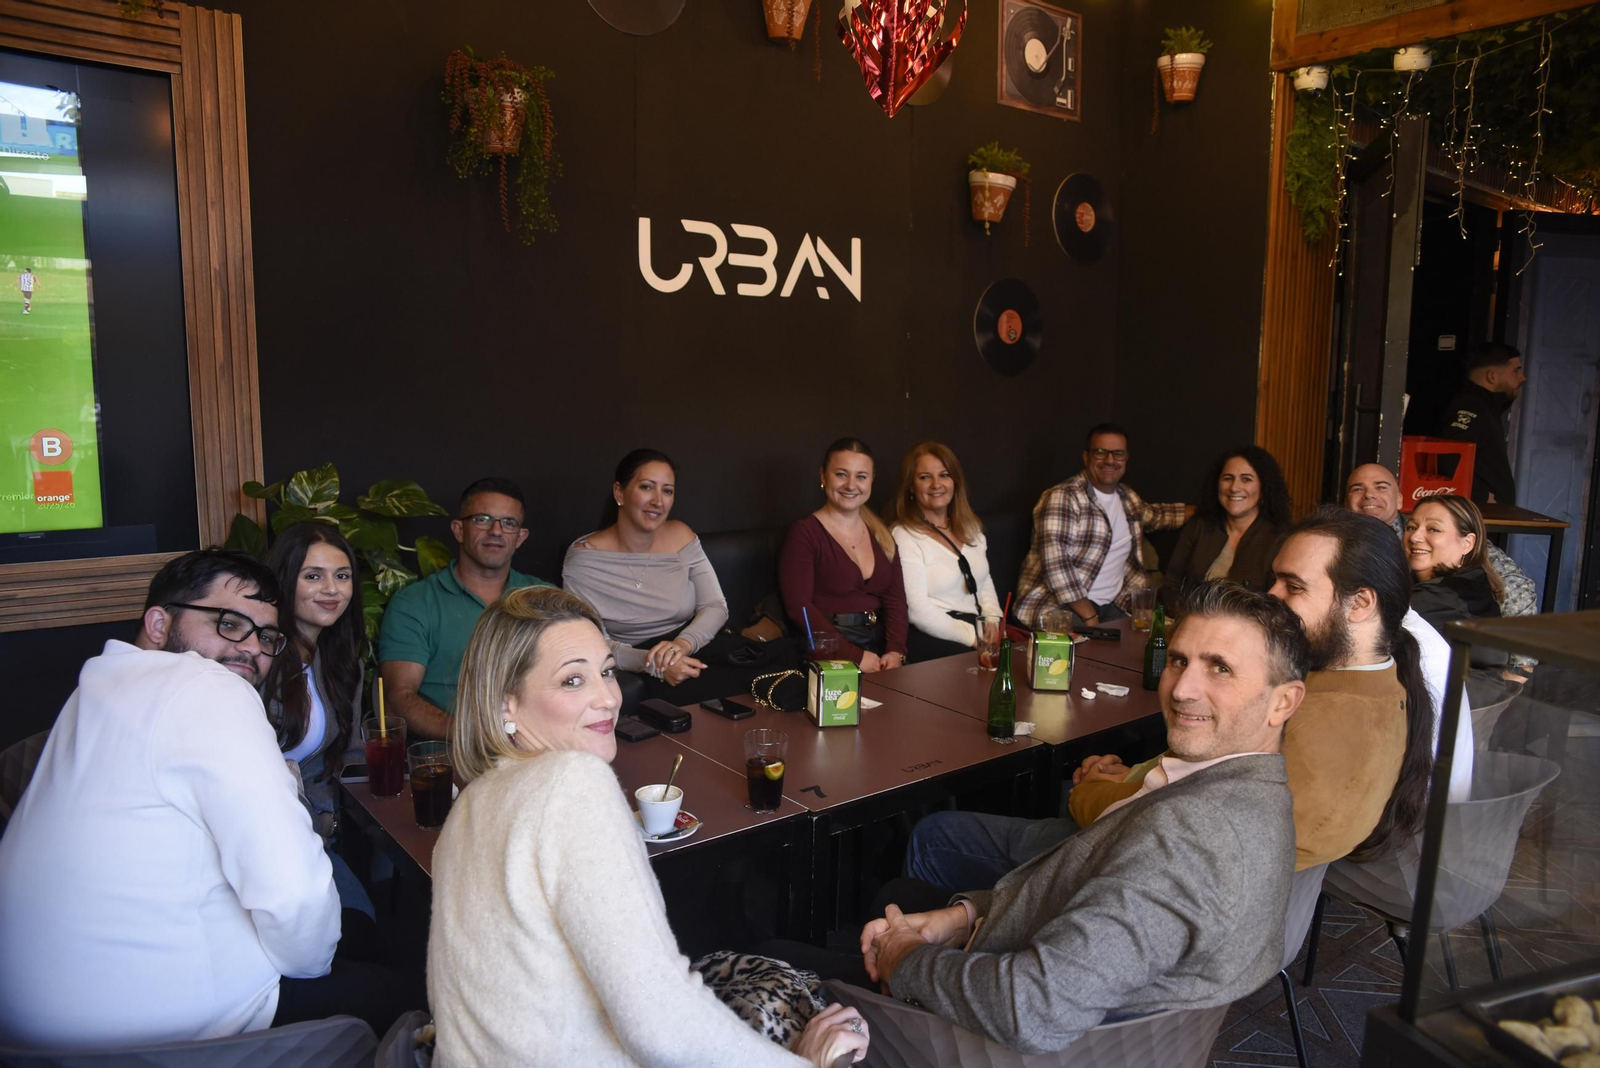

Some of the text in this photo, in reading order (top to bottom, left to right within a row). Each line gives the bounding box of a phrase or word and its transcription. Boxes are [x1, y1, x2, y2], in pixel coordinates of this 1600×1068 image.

[638, 217, 861, 303] URBAN
[42, 437, 62, 456] B
[0, 493, 34, 501] remier
[825, 688, 842, 696] fuze
